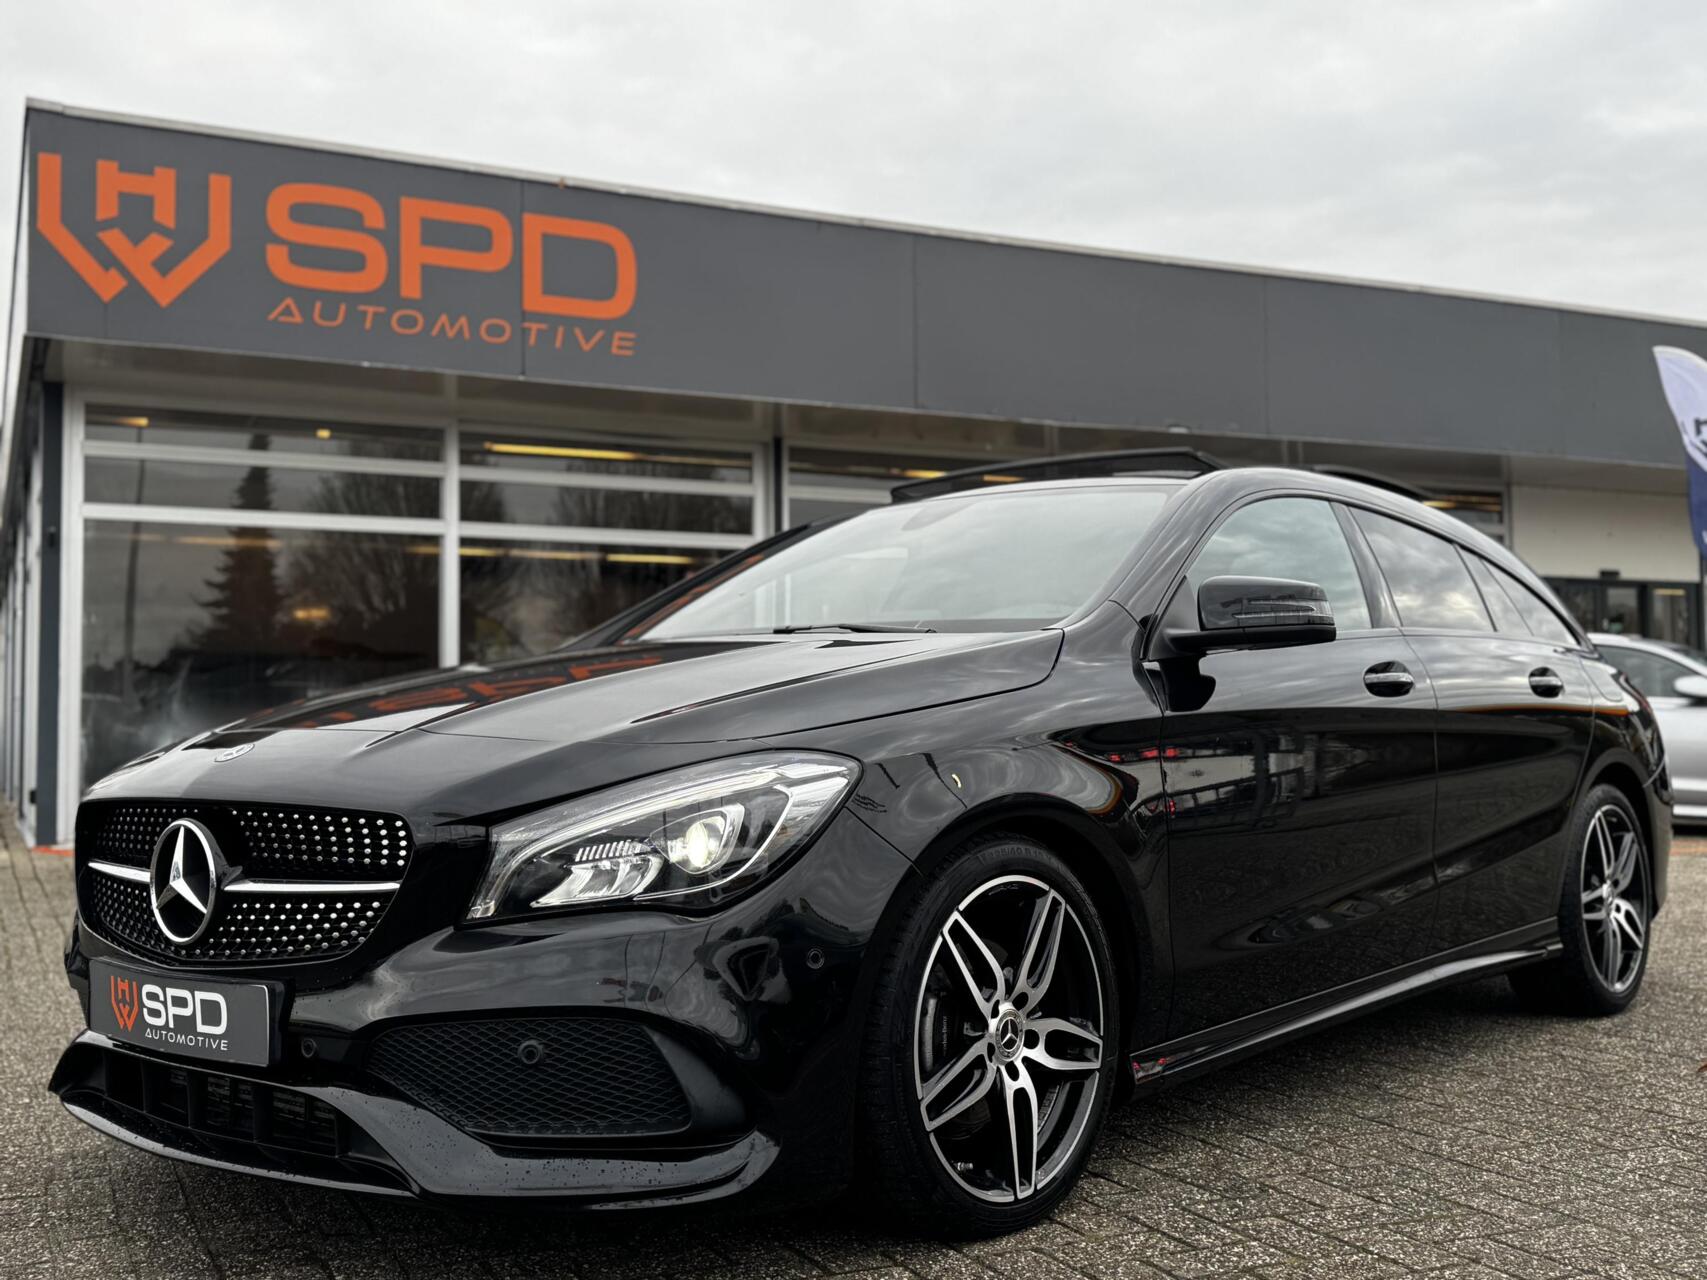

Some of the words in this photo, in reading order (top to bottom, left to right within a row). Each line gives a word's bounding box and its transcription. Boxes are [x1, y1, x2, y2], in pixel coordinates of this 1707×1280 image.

[265, 182, 638, 321] SPD
[268, 297, 636, 357] AUTOMOTIVE
[141, 983, 228, 1035] SPD
[144, 1027, 229, 1051] AUTOMOTIVE
